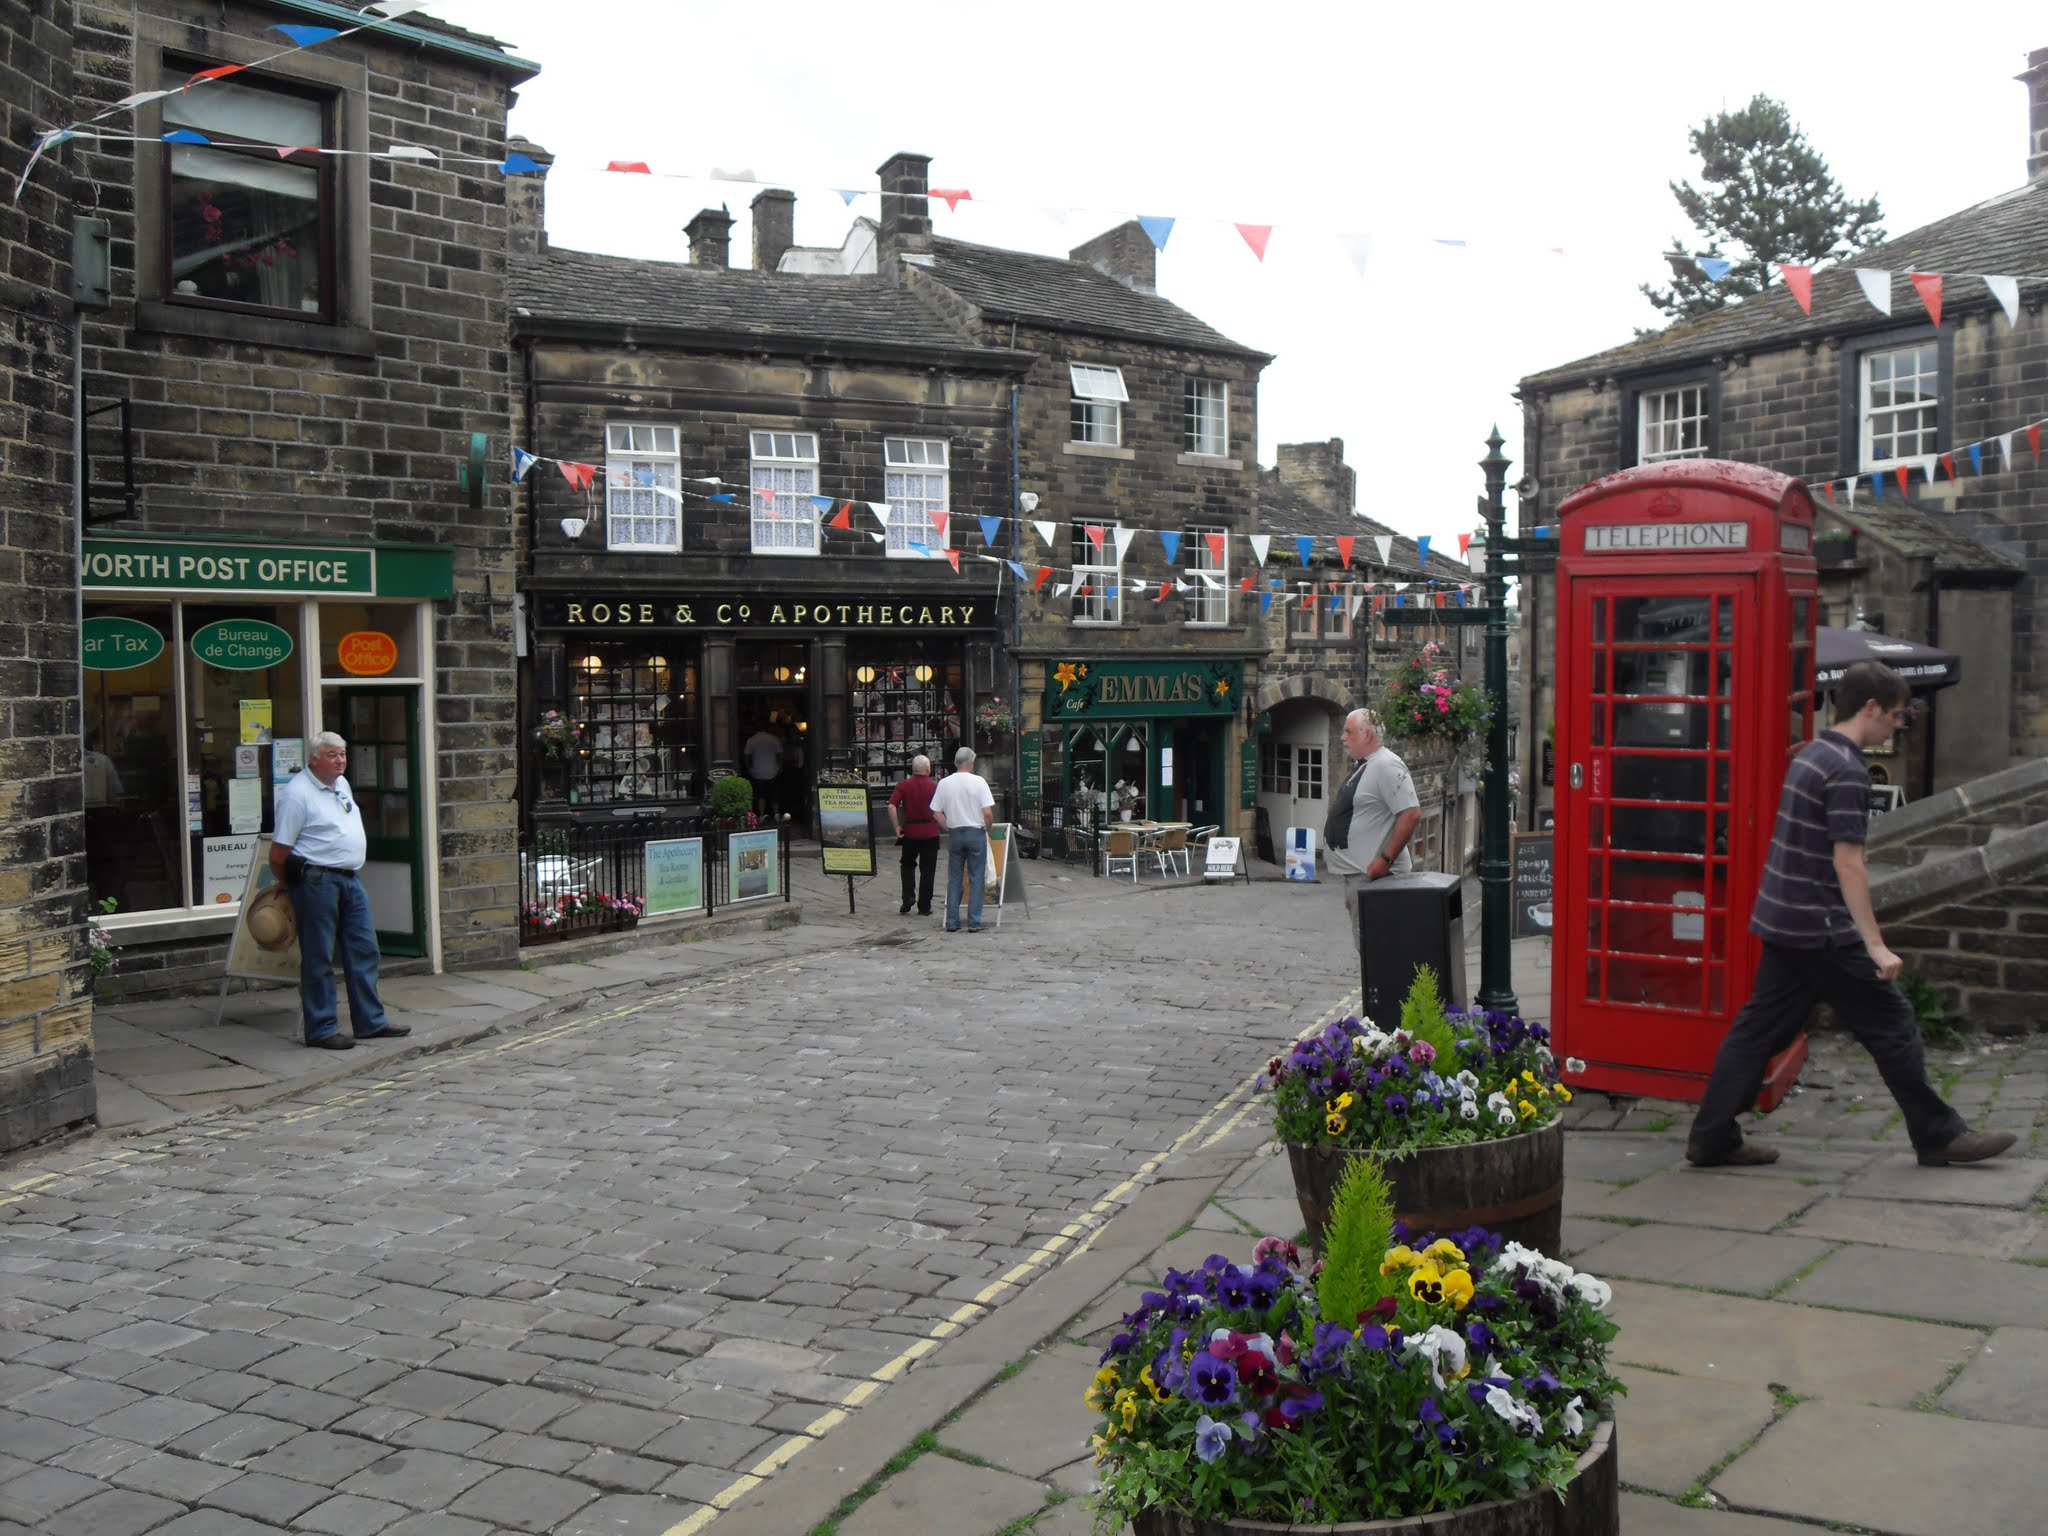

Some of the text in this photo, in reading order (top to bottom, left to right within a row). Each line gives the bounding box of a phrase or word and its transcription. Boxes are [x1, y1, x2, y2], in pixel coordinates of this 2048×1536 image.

[1591, 523, 1742, 547] TELEPHONE
[179, 556, 250, 580] POST
[258, 559, 348, 583] OFFICE
[567, 603, 655, 623] ROSE
[675, 604, 696, 622] &
[770, 604, 975, 625] APOTHECARY
[111, 634, 149, 652] Tax
[218, 628, 268, 641] Bureau
[205, 644, 282, 660] de Change
[351, 637, 382, 651] Post
[344, 652, 391, 666] Office
[1098, 671, 1202, 704] EMMA'S
[1593, 759, 1601, 793] PULL
[207, 842, 248, 853] BUREAU
